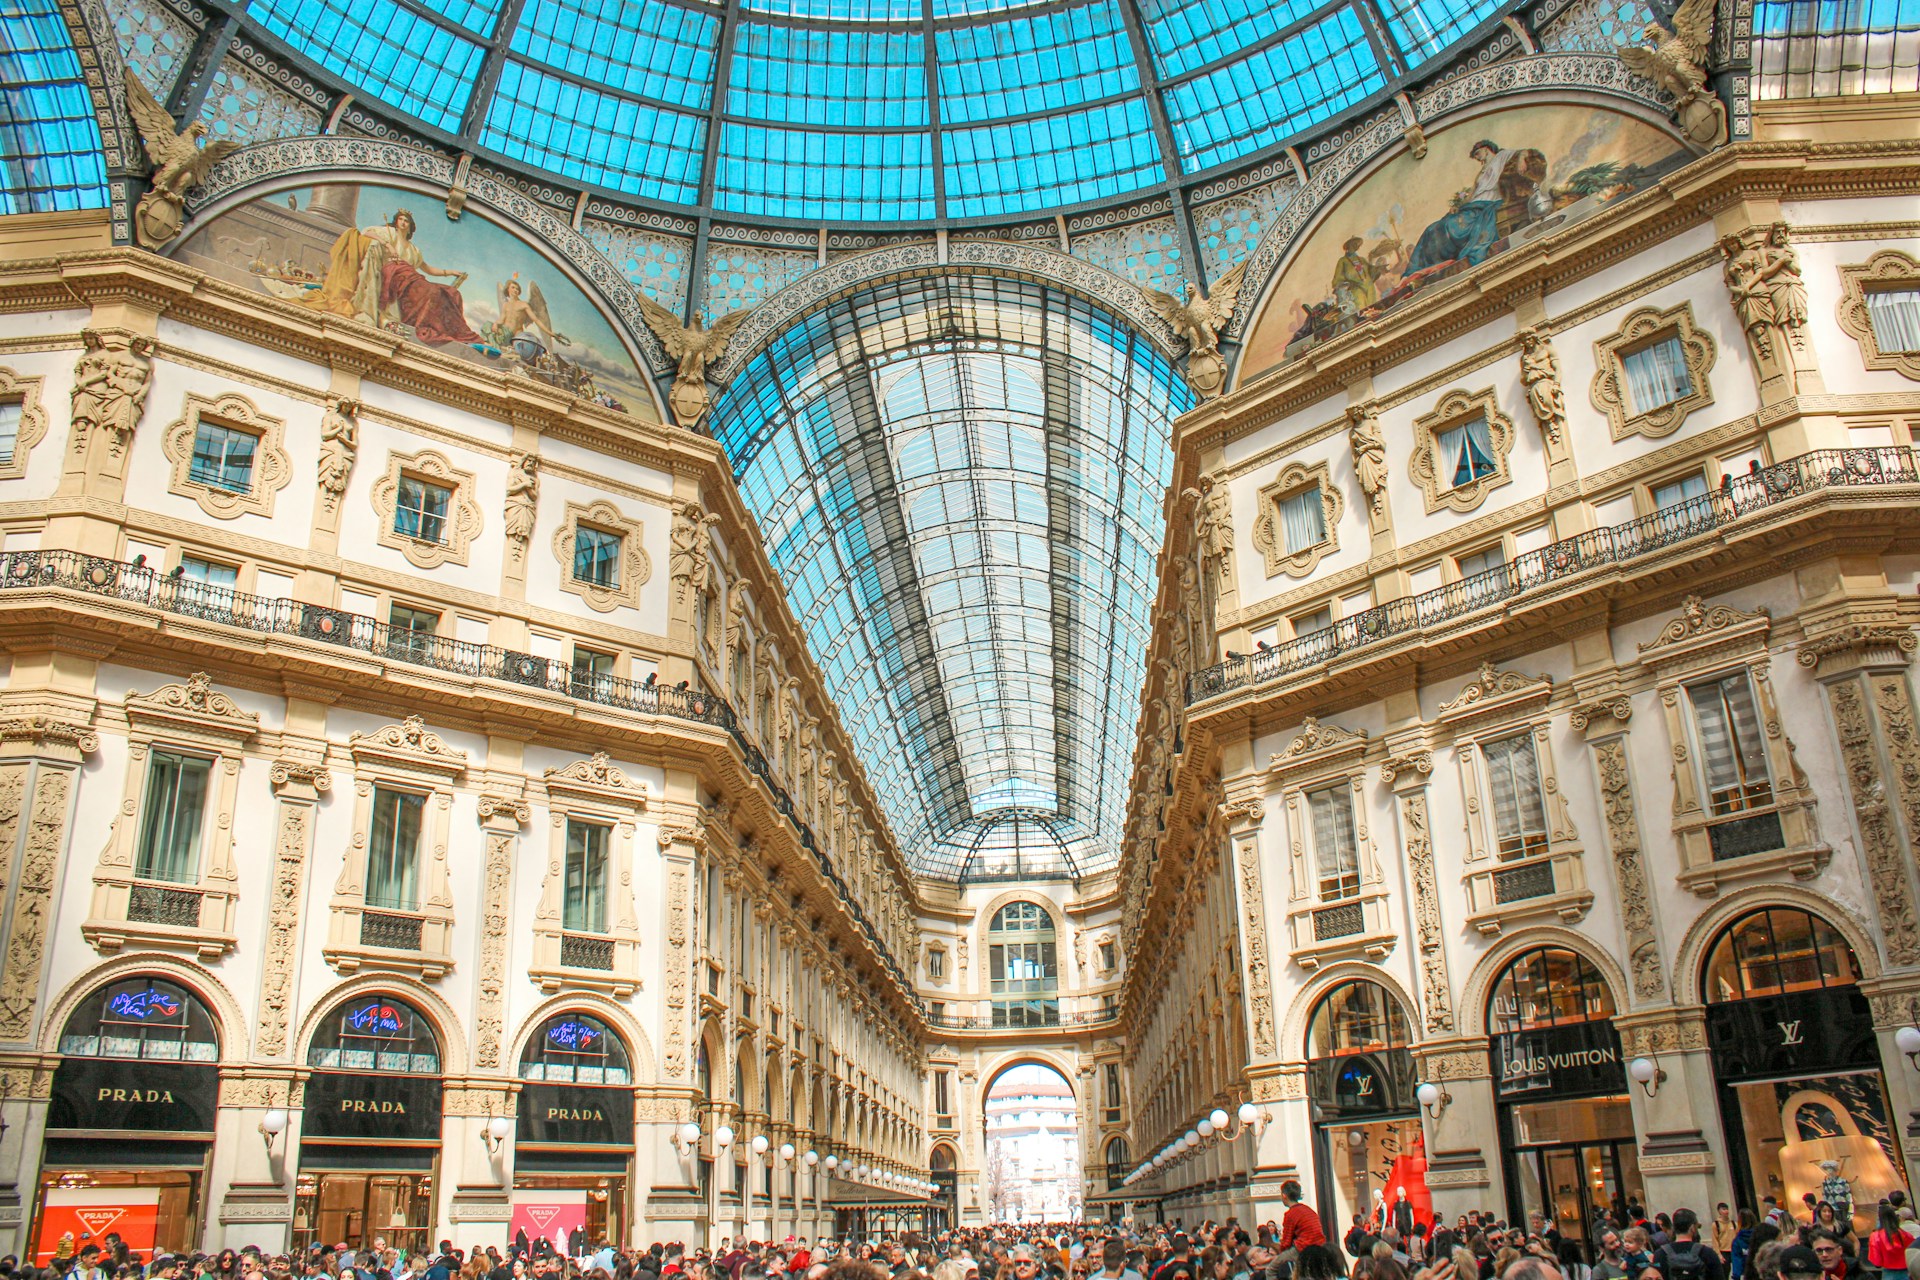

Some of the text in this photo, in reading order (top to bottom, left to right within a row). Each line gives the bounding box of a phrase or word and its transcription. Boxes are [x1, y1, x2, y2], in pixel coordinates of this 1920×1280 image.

[1503, 1047, 1616, 1075] LOUIS VUITTON
[98, 1088, 174, 1104] PRADA
[341, 1099, 406, 1114] PRADA
[547, 1108, 603, 1121] PRADA
